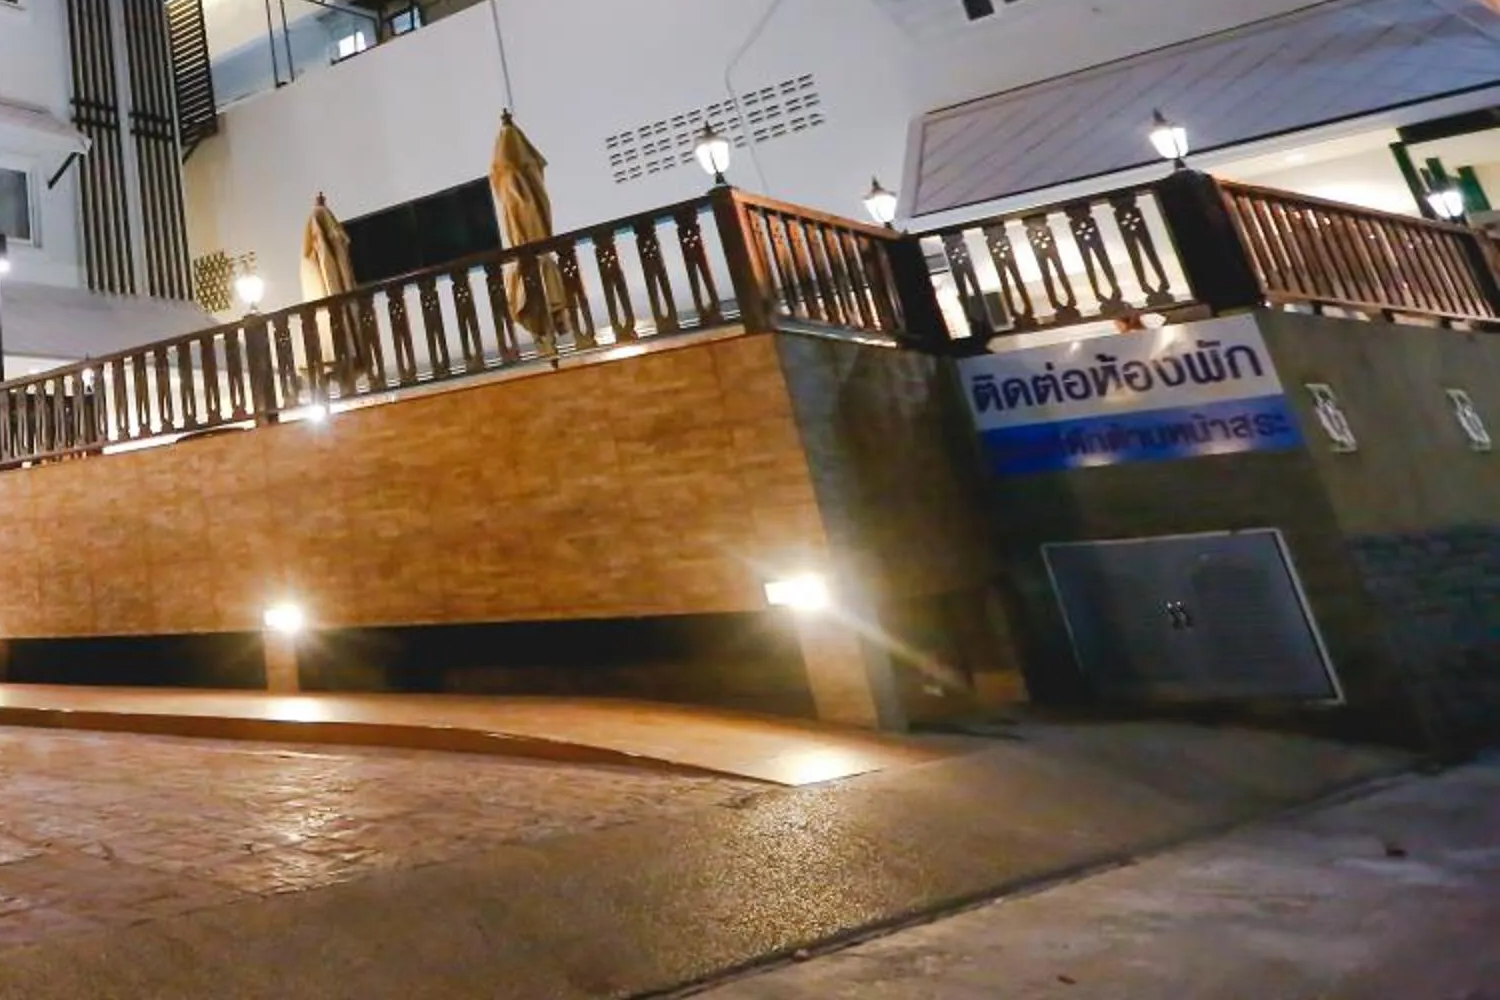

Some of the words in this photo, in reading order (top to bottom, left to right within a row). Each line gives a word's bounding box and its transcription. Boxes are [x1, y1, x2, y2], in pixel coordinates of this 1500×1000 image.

[971, 340, 1264, 414] ติดต่อห้องพัก
